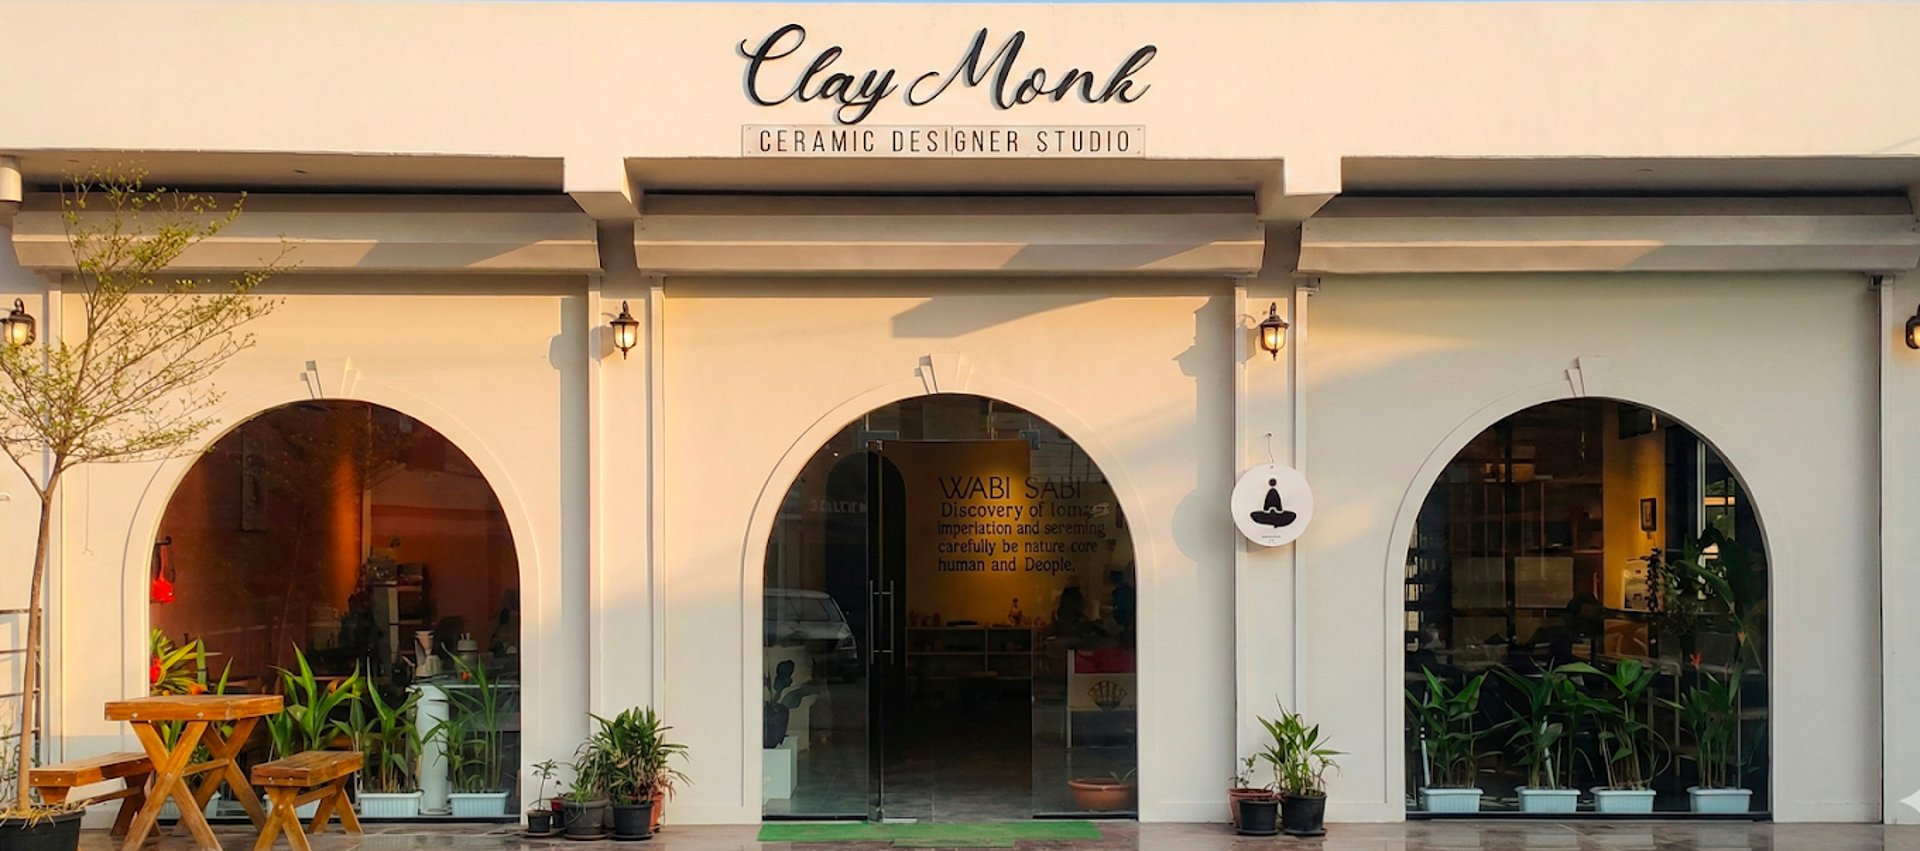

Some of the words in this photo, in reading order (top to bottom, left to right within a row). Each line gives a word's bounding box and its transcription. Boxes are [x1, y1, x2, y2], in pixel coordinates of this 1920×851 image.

[741, 23, 898, 125] Clay
[904, 27, 1157, 109] Monk
[759, 130, 875, 152] CERAMIC
[892, 130, 1019, 152] DESIGNER
[1036, 130, 1131, 152] STUDIO
[938, 476, 1010, 499] WABI
[1024, 476, 1081, 499] SABI
[942, 502, 1023, 521] Discovery
[1029, 501, 1045, 517] of
[1017, 521, 1040, 535] and
[938, 538, 996, 556] carefully
[1002, 539, 1018, 553] be
[1024, 541, 1065, 553] nature
[938, 558, 985, 572] human
[991, 557, 1016, 572] and
